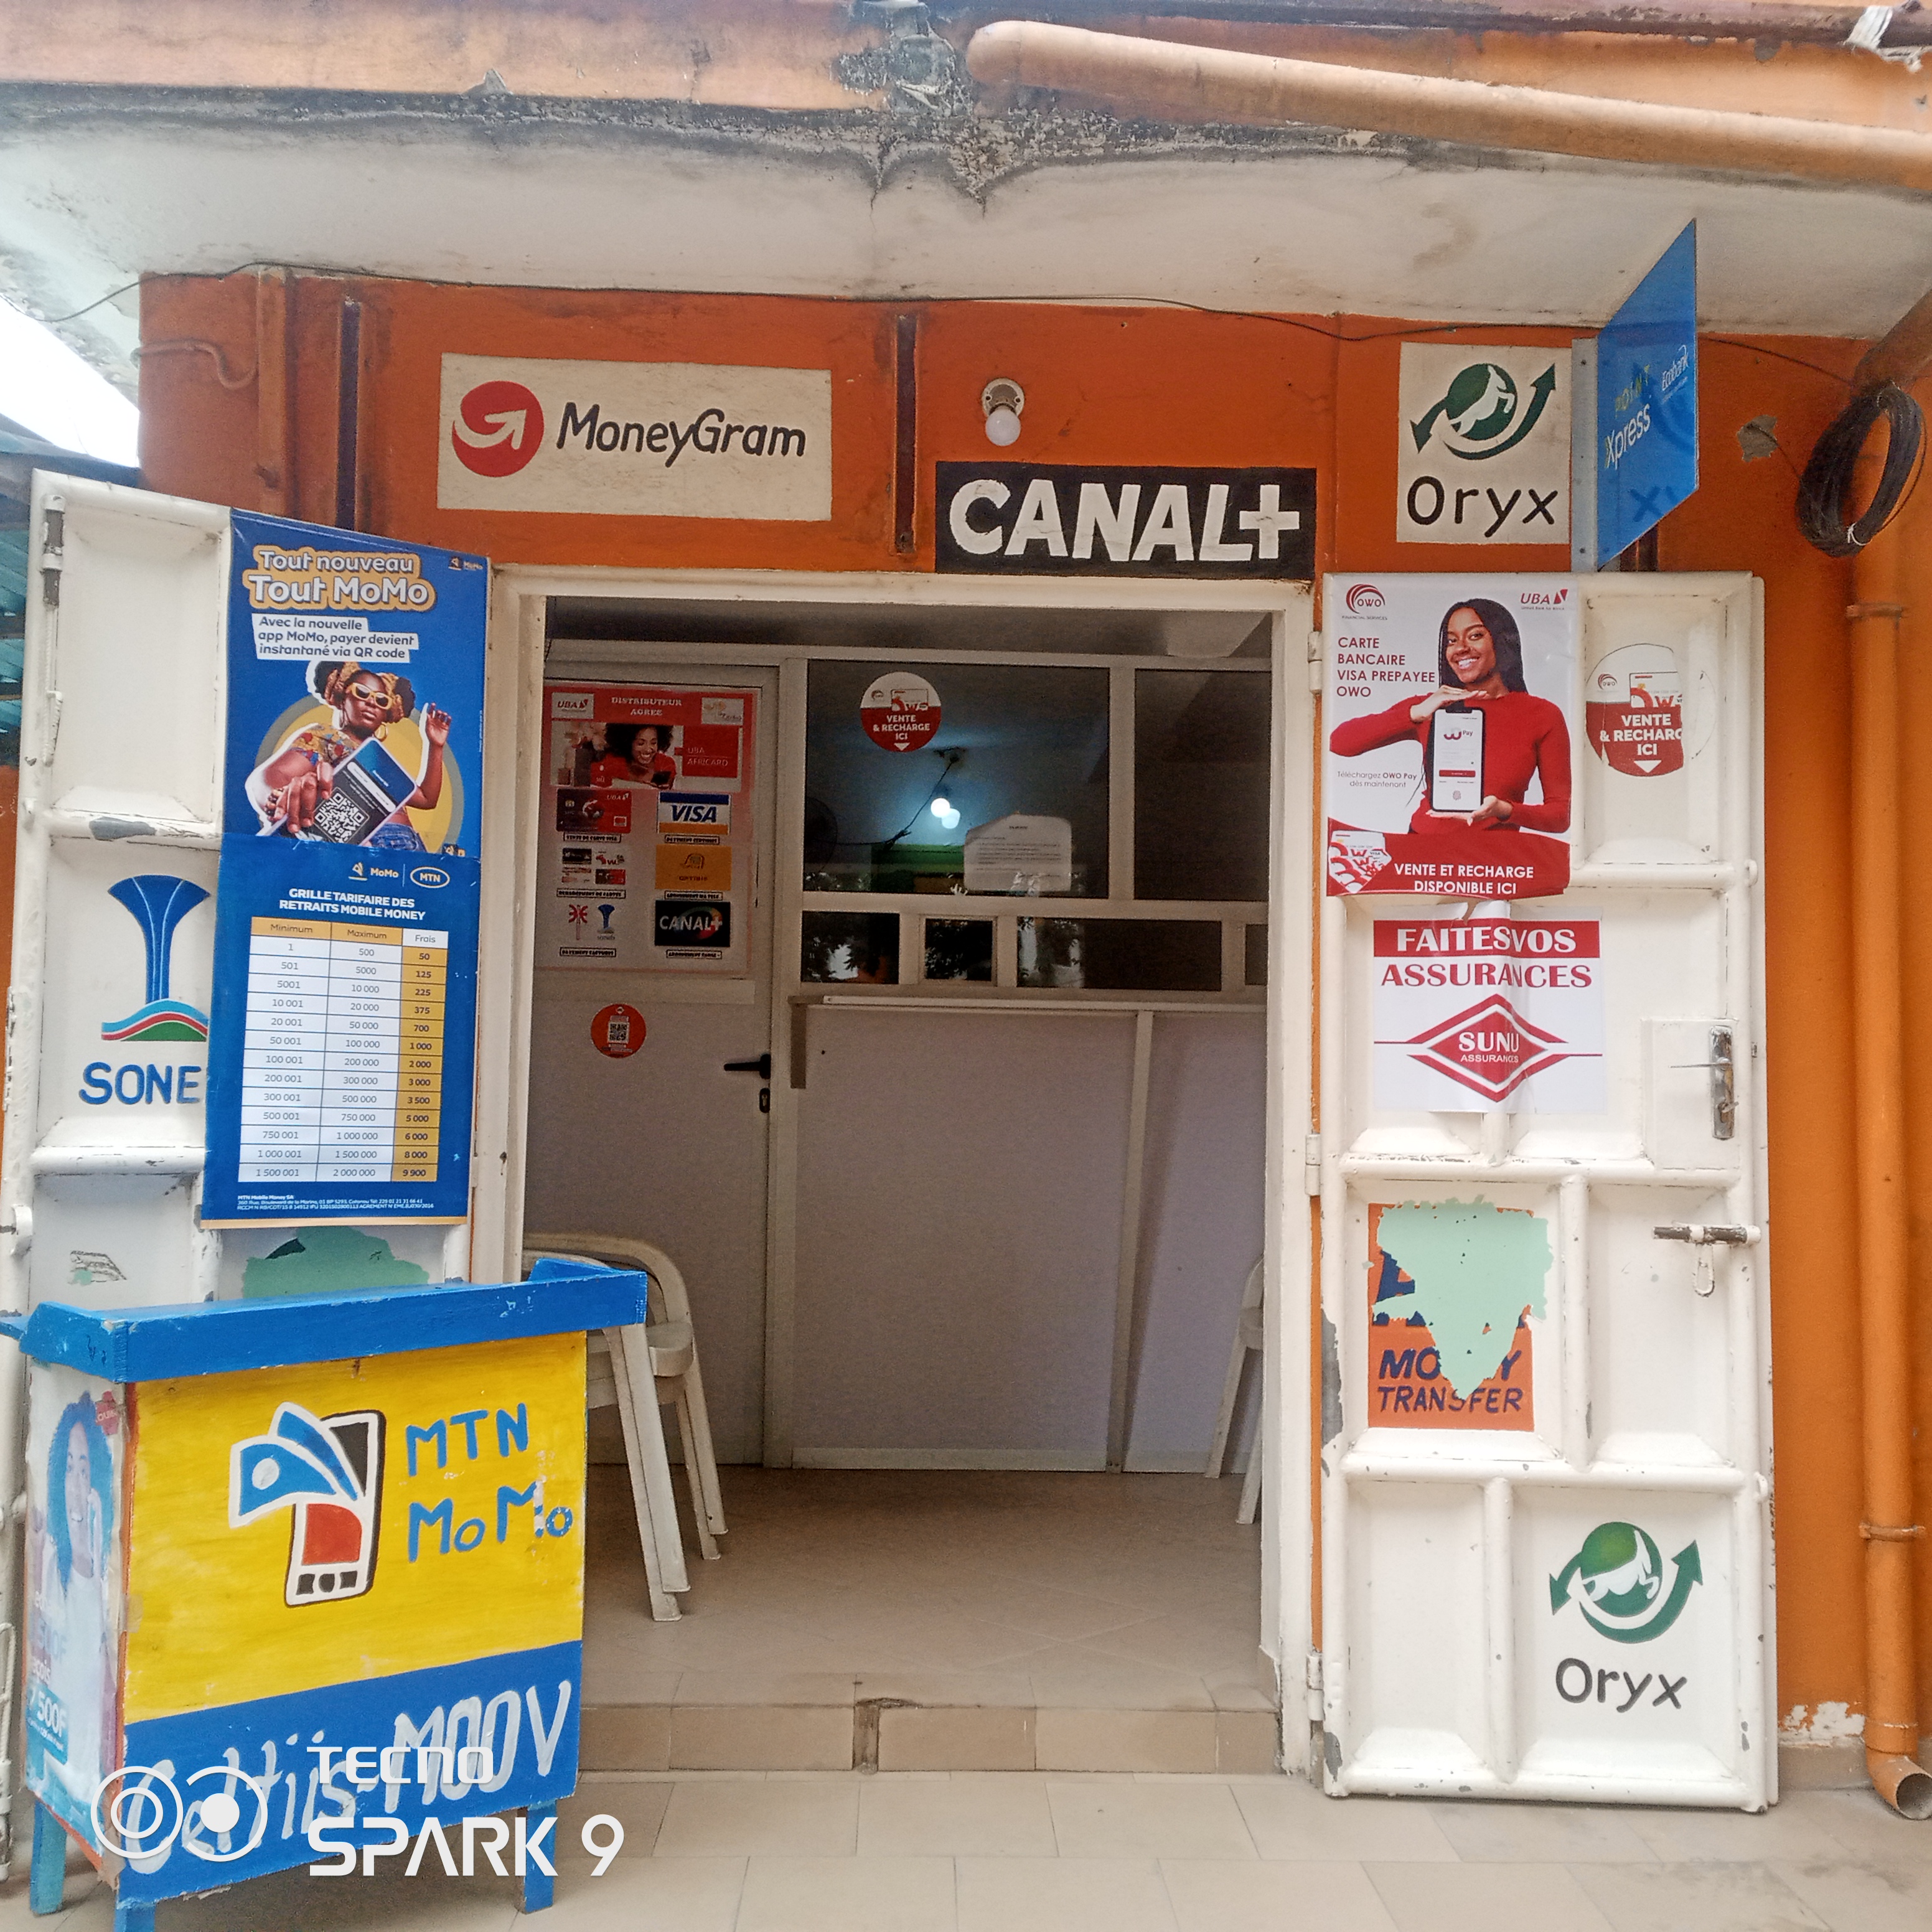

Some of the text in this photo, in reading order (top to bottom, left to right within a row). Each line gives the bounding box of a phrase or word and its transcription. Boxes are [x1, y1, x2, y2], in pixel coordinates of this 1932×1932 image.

[556, 402, 805, 467] MoneyGram
[1407, 476, 1558, 538] Oryx
[949, 479, 1300, 561] CANAL+
[259, 550, 413, 573] Tout nouveau
[250, 575, 428, 604] Tout MoMo
[1521, 593, 1550, 604] UBA
[259, 616, 362, 630] Avec la nouvelle
[258, 631, 414, 649] app MoMo, payer devient
[1338, 637, 1379, 649] CARTE
[259, 644, 405, 659] instantané via QR code
[1338, 654, 1405, 665] BANCAIRE
[1337, 670, 1435, 683] VISA PREPAYEE
[1336, 686, 1371, 698] OWO
[611, 696, 682, 706] DISTRIBUTEUR
[1621, 714, 1671, 726] VENTE
[881, 723, 931, 731] RECHARGE
[1600, 728, 1682, 742] & RECHARG
[1637, 744, 1658, 756] ICI
[1338, 771, 1381, 780] Téléchargez
[1404, 772, 1417, 781] Pay
[1349, 779, 1364, 787] dès
[671, 805, 717, 822] VISA
[370, 868, 441, 883] MoMo MTN
[1394, 863, 1534, 878] VENTE ET RECHARGE
[1414, 880, 1517, 894] DISPONIBLE ICI
[289, 888, 415, 908] GRILLE TARIFAIRE DES
[279, 900, 426, 921] RETRAITS MOBILE MONEY
[271, 924, 312, 933] Minimum
[659, 916, 723, 931] CANAL+
[347, 929, 387, 939] Maximum
[415, 935, 436, 944] Frais
[1397, 926, 1577, 953] FAITES VOS
[359, 949, 374, 957] 500
[281, 962, 299, 970] 501
[356, 967, 377, 975] 5000
[416, 970, 431, 978] 125
[1381, 963, 1592, 988] ASSURANCES
[277, 980, 301, 989] 5001
[351, 985, 380, 993] 10 000
[415, 988, 431, 996] 225
[272, 999, 303, 1008] 10 001
[350, 1003, 379, 1011] 20 000
[415, 1006, 430, 1015] 375
[271, 1018, 302, 1026] 20 001
[349, 1021, 378, 1029] 50 000
[270, 1036, 301, 1045] 50 001
[346, 1039, 380, 1048] 100 000
[1458, 1031, 1519, 1053] SUNU
[415, 1043, 432, 1051] 000
[266, 1056, 303, 1064] 100 001
[344, 1058, 360, 1066] 200
[1460, 1054, 1519, 1063] ASSURANCES
[79, 1061, 203, 1105] SONE
[265, 1074, 302, 1083] 200 001
[344, 1077, 378, 1085] 300 000
[264, 1093, 301, 1102] 300 001
[360, 1095, 377, 1104] 000
[263, 1112, 299, 1120] 500 001
[262, 1131, 299, 1139] 750 001
[263, 1150, 280, 1158] 000
[283, 1150, 301, 1158] 001
[1379, 1346, 1522, 1381] MOY
[1377, 1386, 1523, 1413] TRANSFER
[406, 1402, 529, 1477] MTN
[407, 1479, 574, 1563] MoMo
[1555, 1658, 1687, 1714] Oryx
[385, 1680, 571, 1814] MOOV
